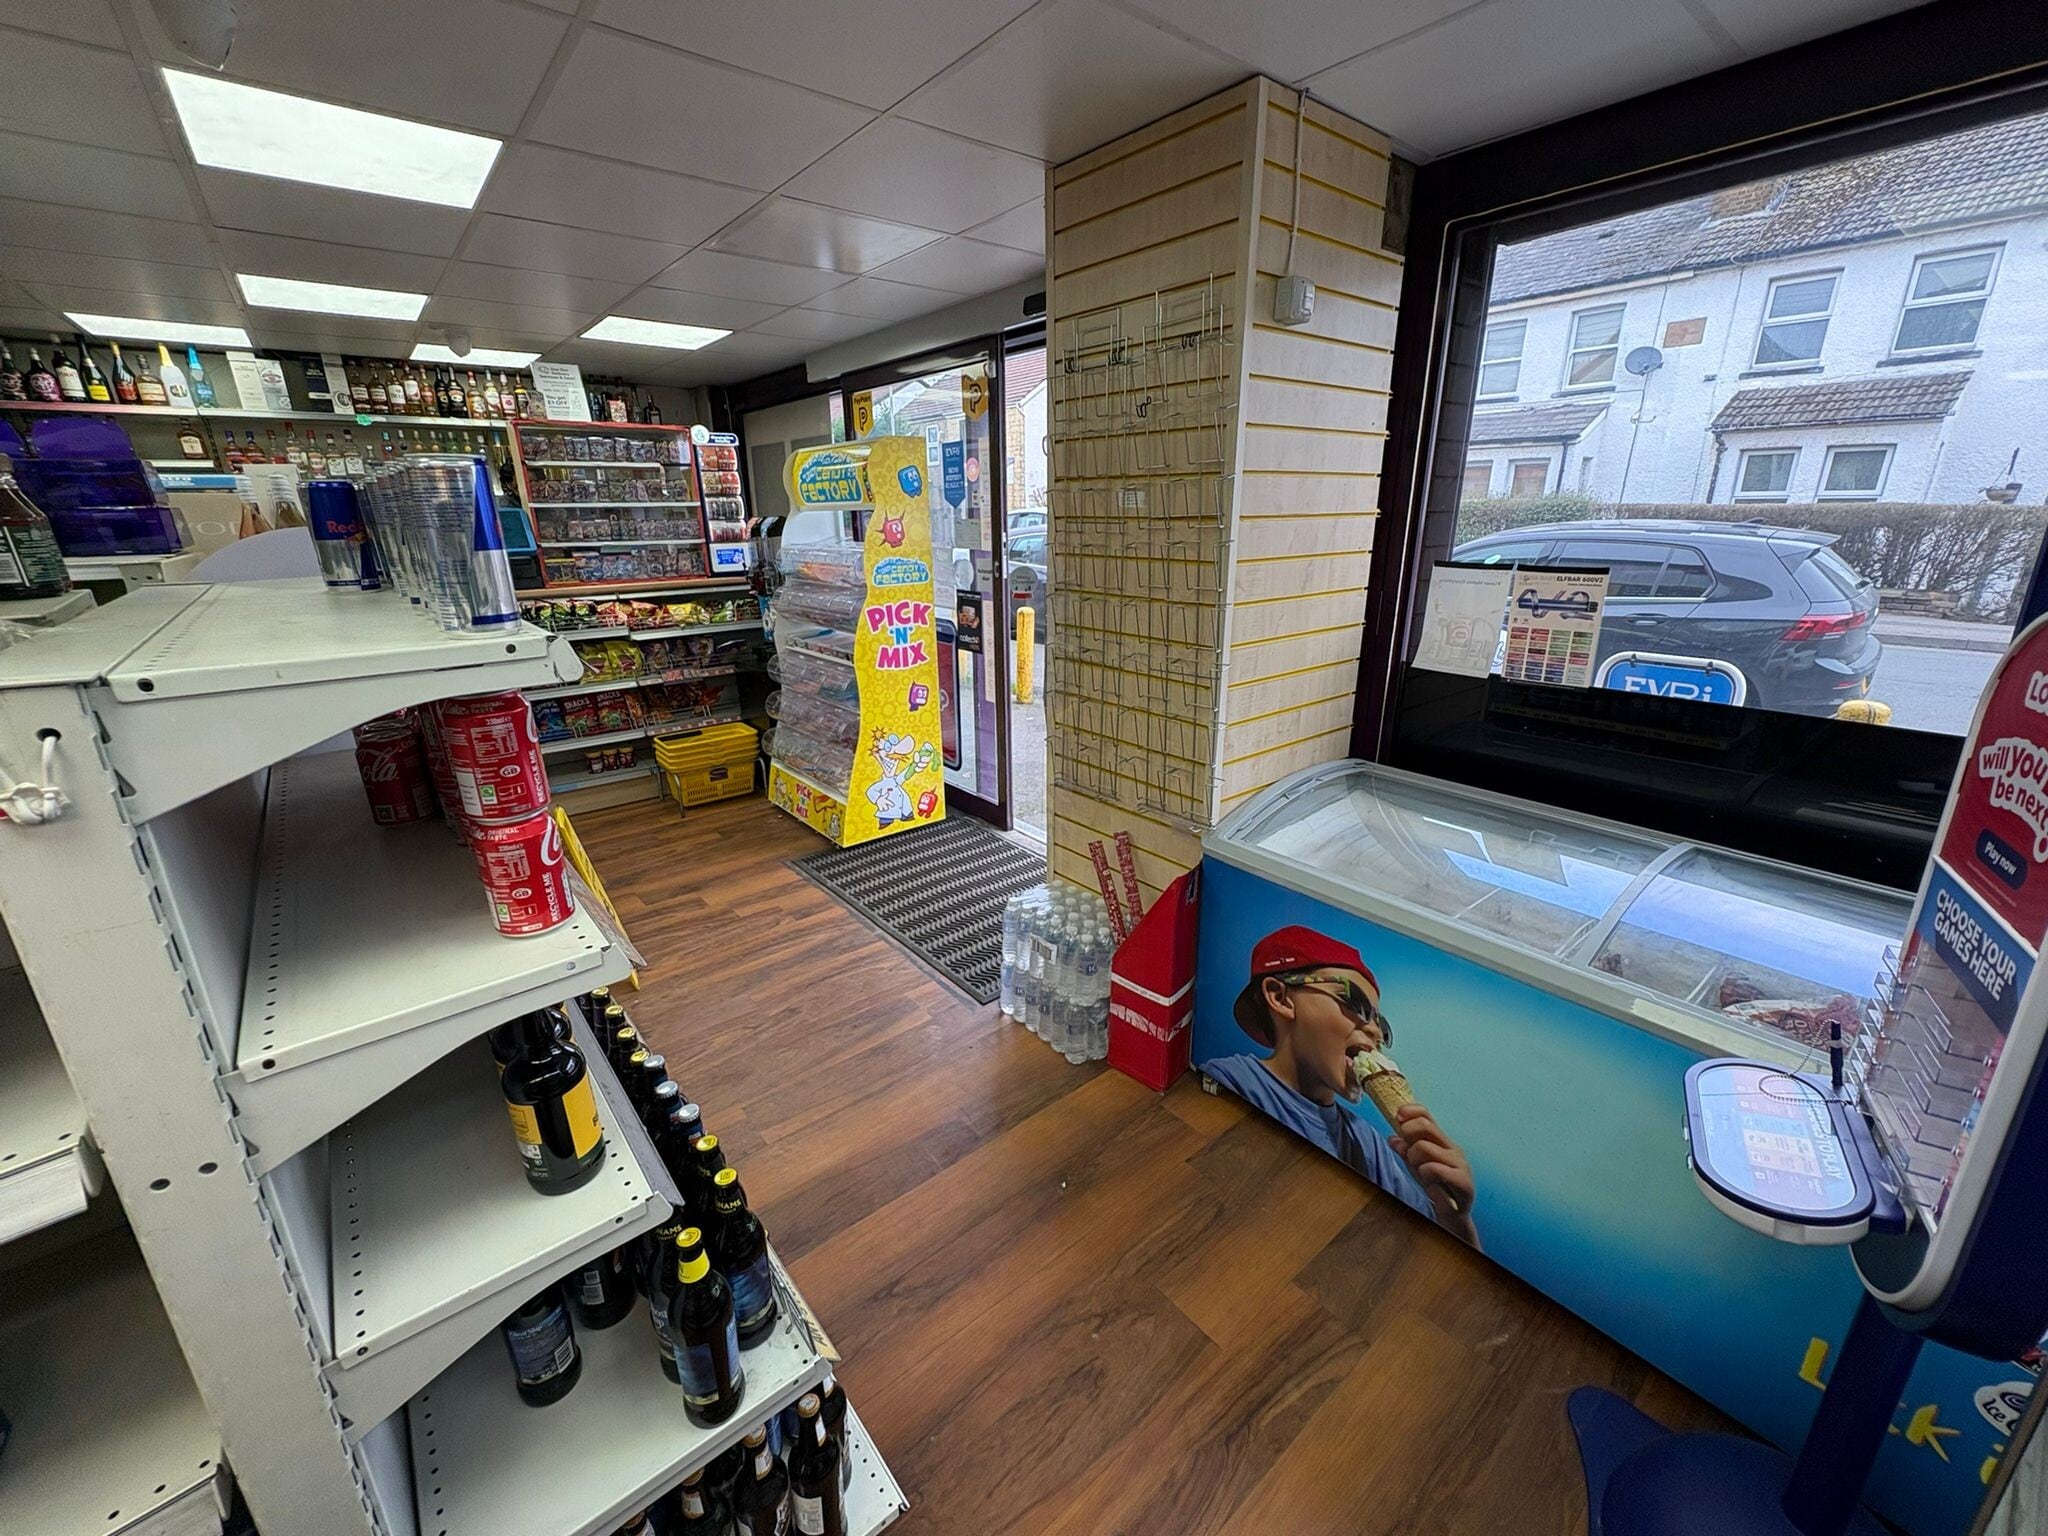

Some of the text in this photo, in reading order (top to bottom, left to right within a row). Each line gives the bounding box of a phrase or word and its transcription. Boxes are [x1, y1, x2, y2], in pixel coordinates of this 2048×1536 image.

[1556, 575, 1604, 584] ELFBAR 600V2
[866, 601, 932, 633] PICK
[877, 641, 928, 669] MIX
[502, 767, 519, 777] GB
[1983, 745, 2048, 785] will you
[1995, 775, 2015, 800] be
[486, 826, 520, 836] ORIGINAL
[1984, 840, 2018, 876] Play now
[514, 889, 530, 899] GB
[1936, 888, 1983, 946] CHOOSE
[1981, 932, 2017, 986] YOUR
[1934, 912, 1973, 964] GAMES
[1968, 951, 2006, 1001] HERE
[1982, 1398, 2007, 1424] Ice
